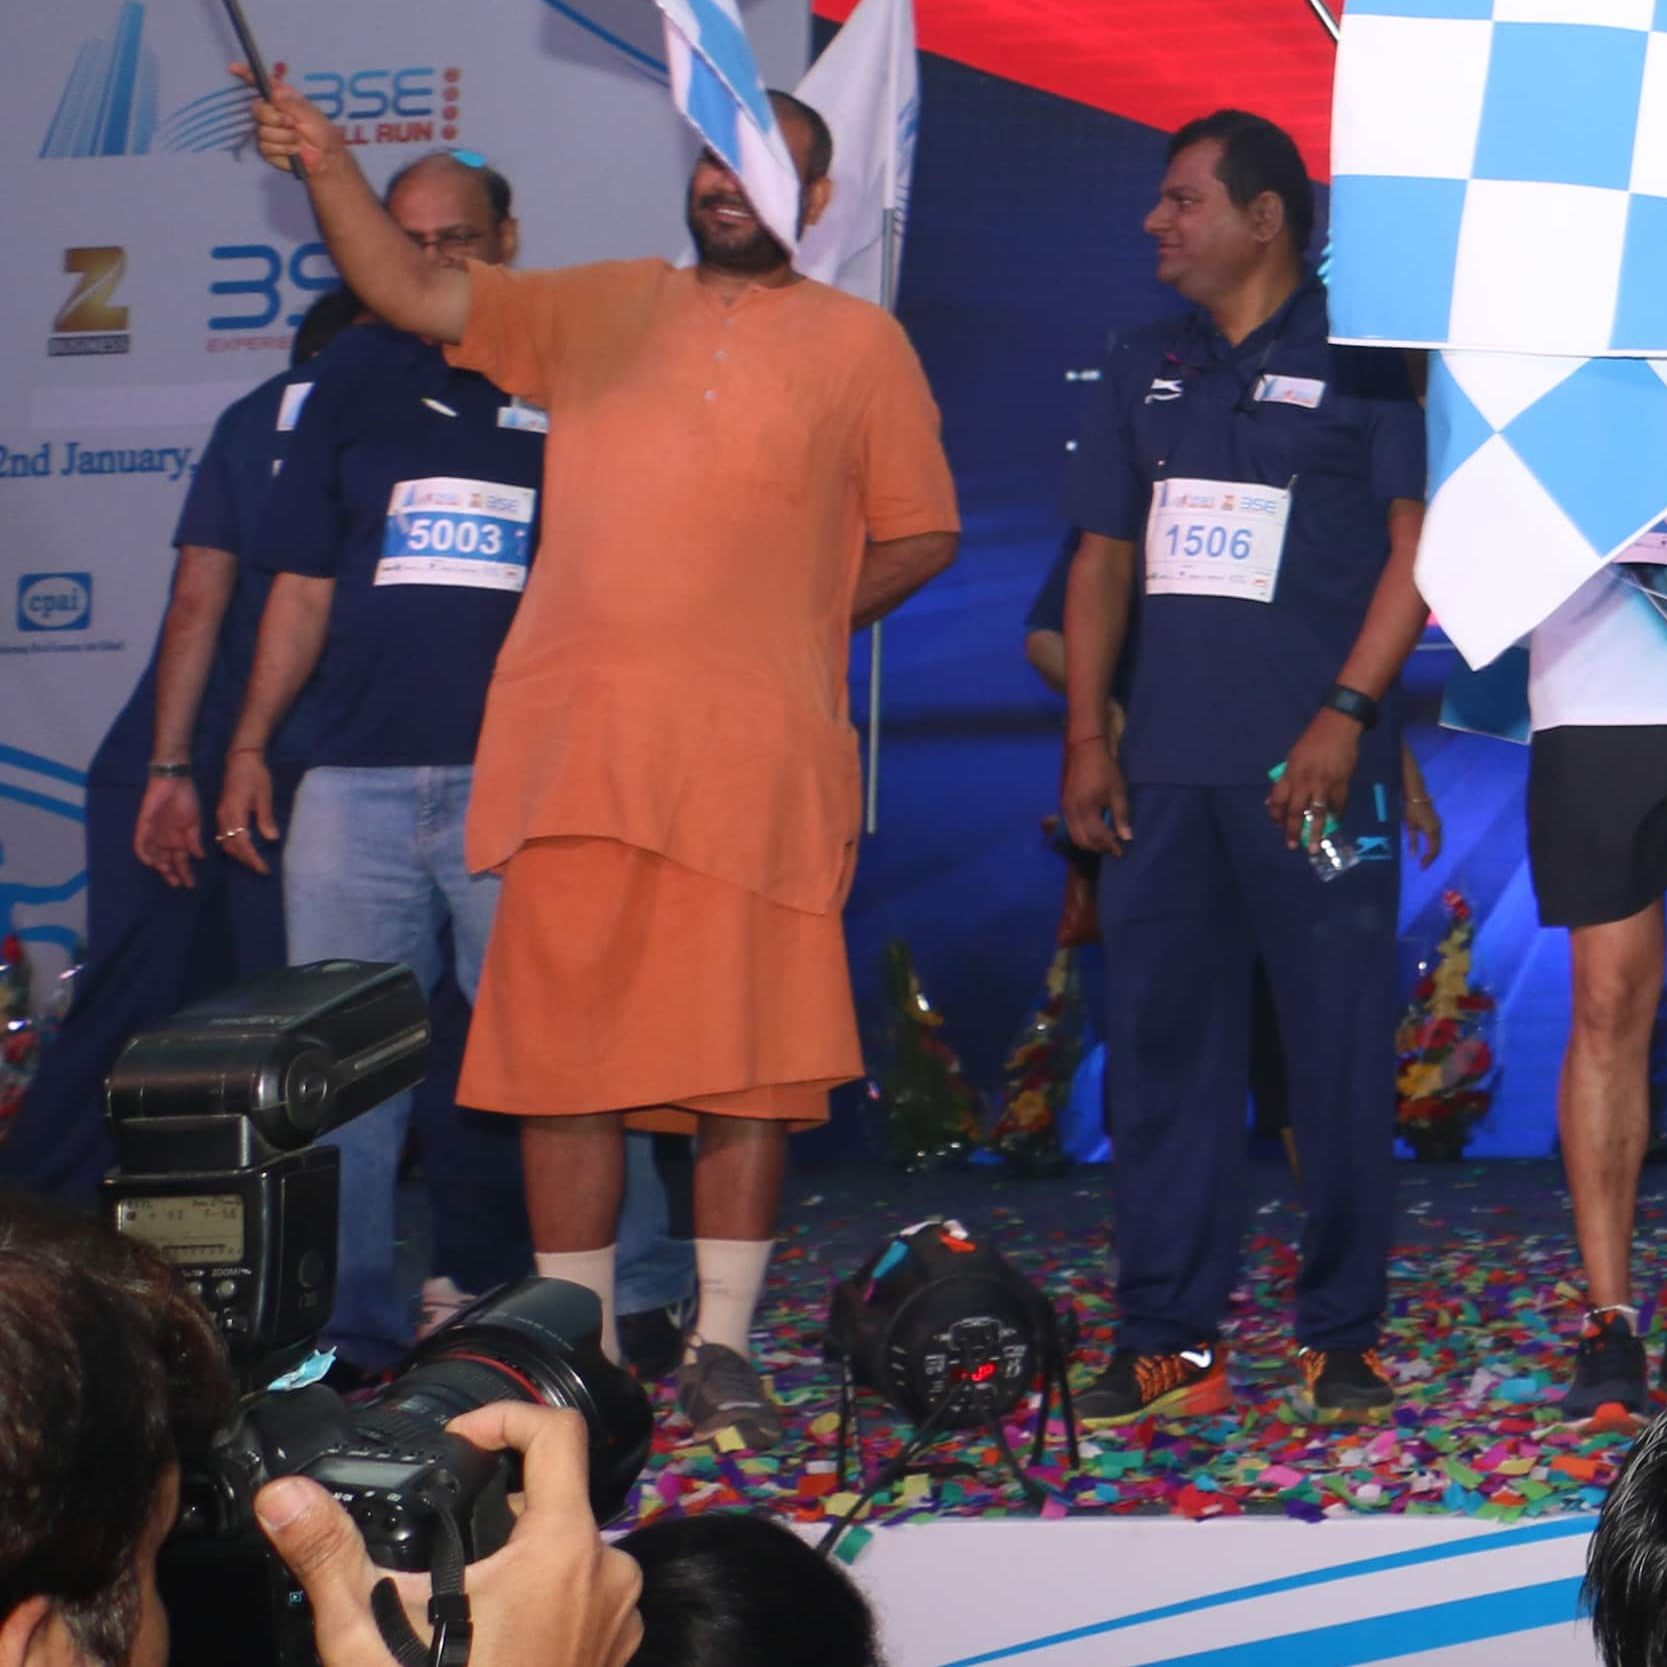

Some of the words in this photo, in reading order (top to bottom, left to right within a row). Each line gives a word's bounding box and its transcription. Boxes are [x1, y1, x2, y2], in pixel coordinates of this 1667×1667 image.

[376, 122, 434, 143] RUN
[406, 518, 502, 556] 5003
[1166, 524, 1254, 561] 1506
[28, 586, 80, 619] cpai
